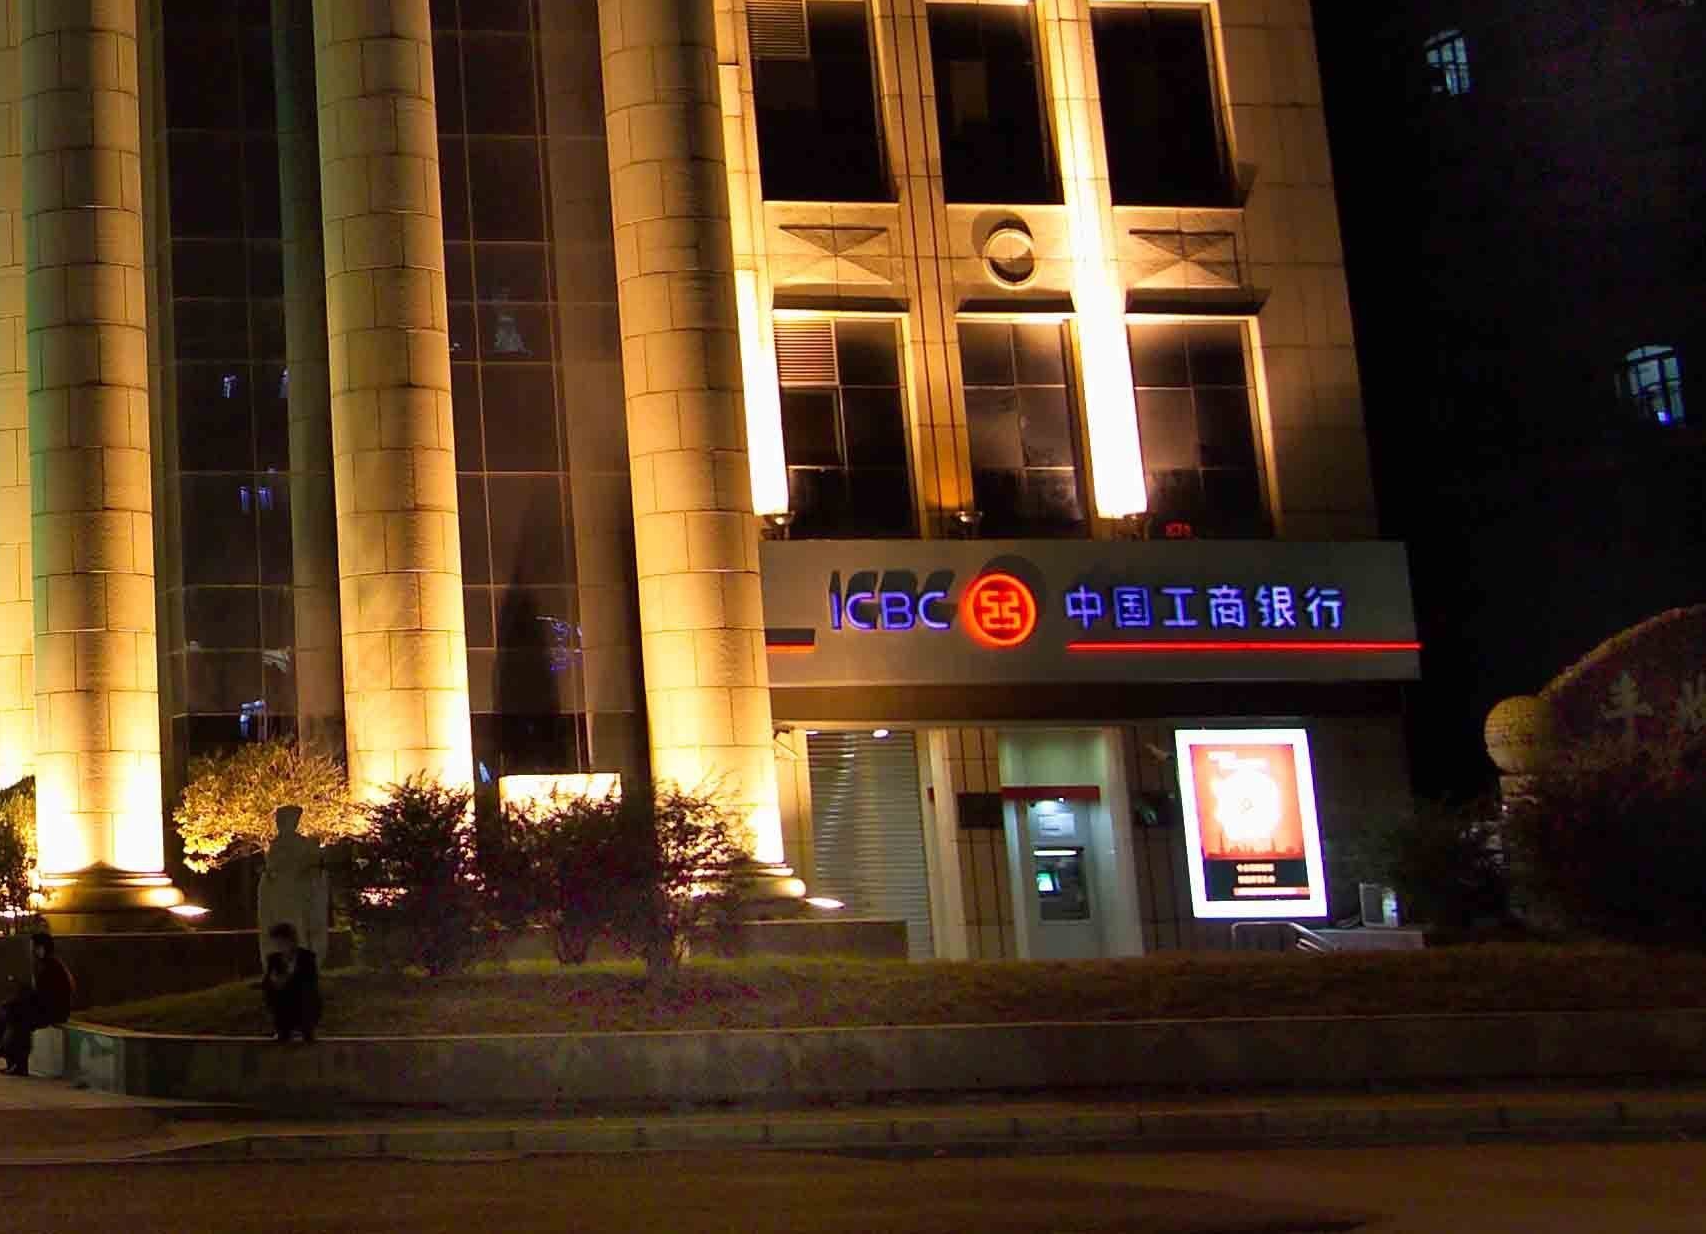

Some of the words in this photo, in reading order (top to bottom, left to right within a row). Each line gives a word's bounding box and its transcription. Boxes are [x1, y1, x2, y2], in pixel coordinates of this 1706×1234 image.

[828, 589, 951, 630] ICBC
[1063, 584, 1344, 630] 中国工商银行
